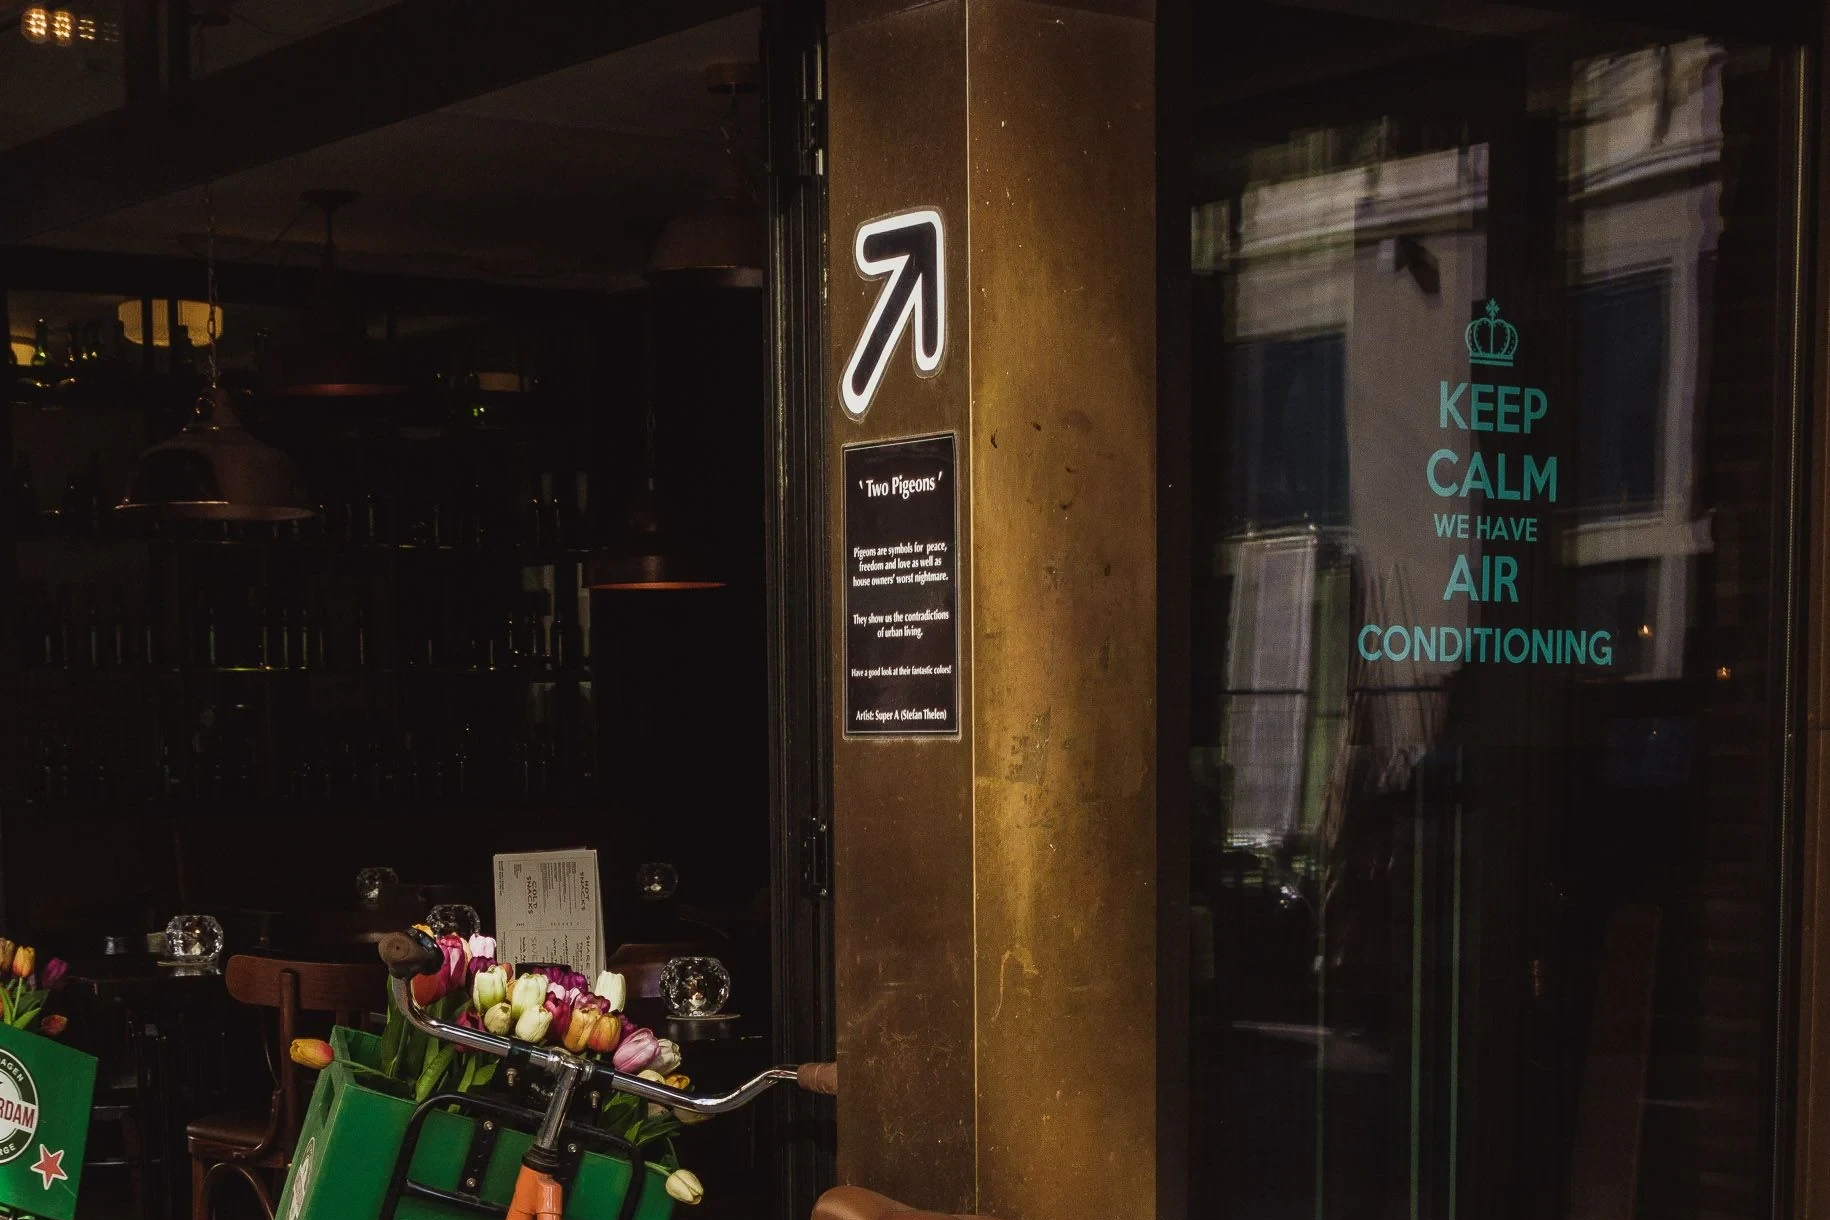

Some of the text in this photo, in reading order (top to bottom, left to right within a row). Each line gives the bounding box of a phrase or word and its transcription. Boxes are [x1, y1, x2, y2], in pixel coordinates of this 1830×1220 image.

[1439, 380, 1548, 434] KEEP
[1426, 448, 1557, 502] CALM
[1433, 513, 1538, 542] WE HAVE
[853, 541, 948, 560] Pigeons are symbols for peace,
[859, 555, 942, 572] freedom and love as well as
[853, 575, 870, 587] house
[896, 572, 914, 584] worst
[914, 570, 949, 585] nightmare.
[1442, 553, 1519, 603] AIR
[853, 608, 949, 627] They show us the contradictions
[877, 627, 885, 638] of
[885, 626, 903, 638] urban
[1357, 624, 1613, 666] CONDITIONING
[851, 668, 864, 677] Have
[868, 667, 881, 679] good
[881, 666, 892, 676] look
[899, 665, 911, 676] their
[911, 664, 933, 675] fantastic
[856, 707, 947, 723] Artist: Super A (Stefan Thelen)
